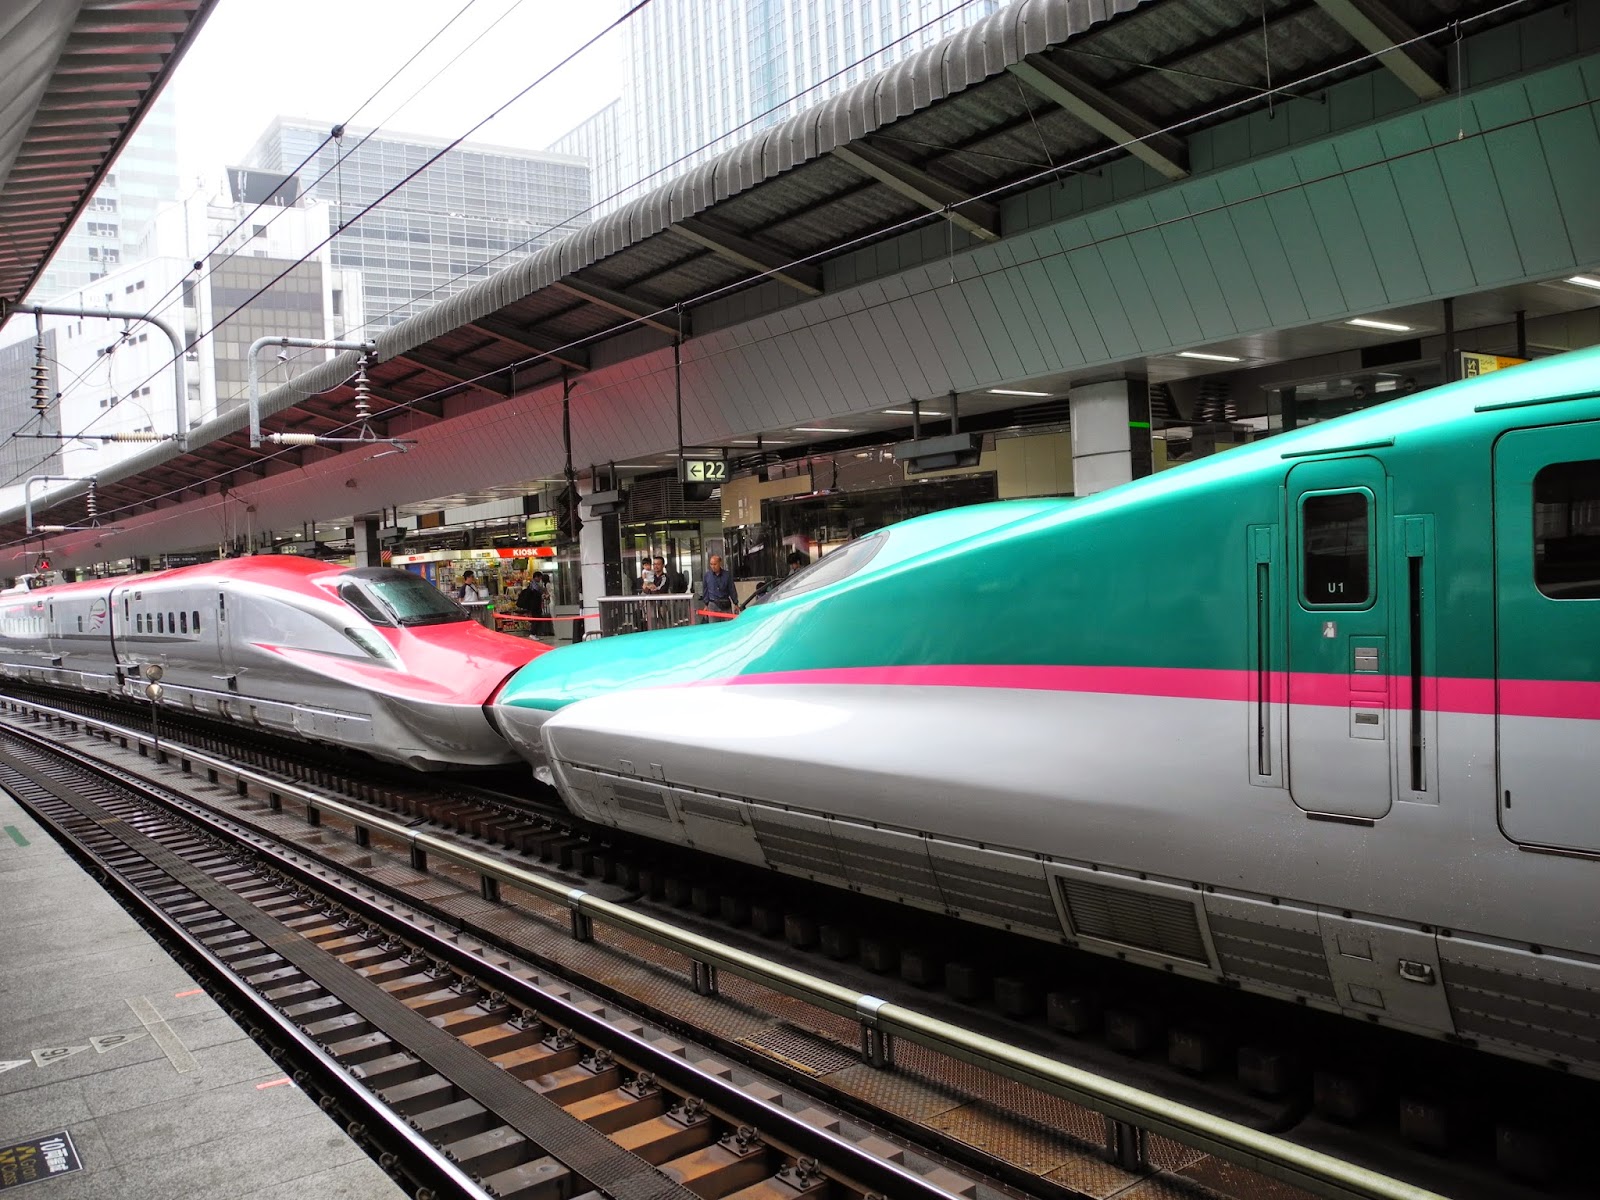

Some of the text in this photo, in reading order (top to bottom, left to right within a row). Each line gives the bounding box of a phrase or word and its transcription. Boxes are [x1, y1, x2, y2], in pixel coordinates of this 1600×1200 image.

[705, 461, 726, 479] 22
[513, 548, 538, 556] KIOSK
[1328, 582, 1345, 593] U1
[98, 1035, 128, 1048] 10
